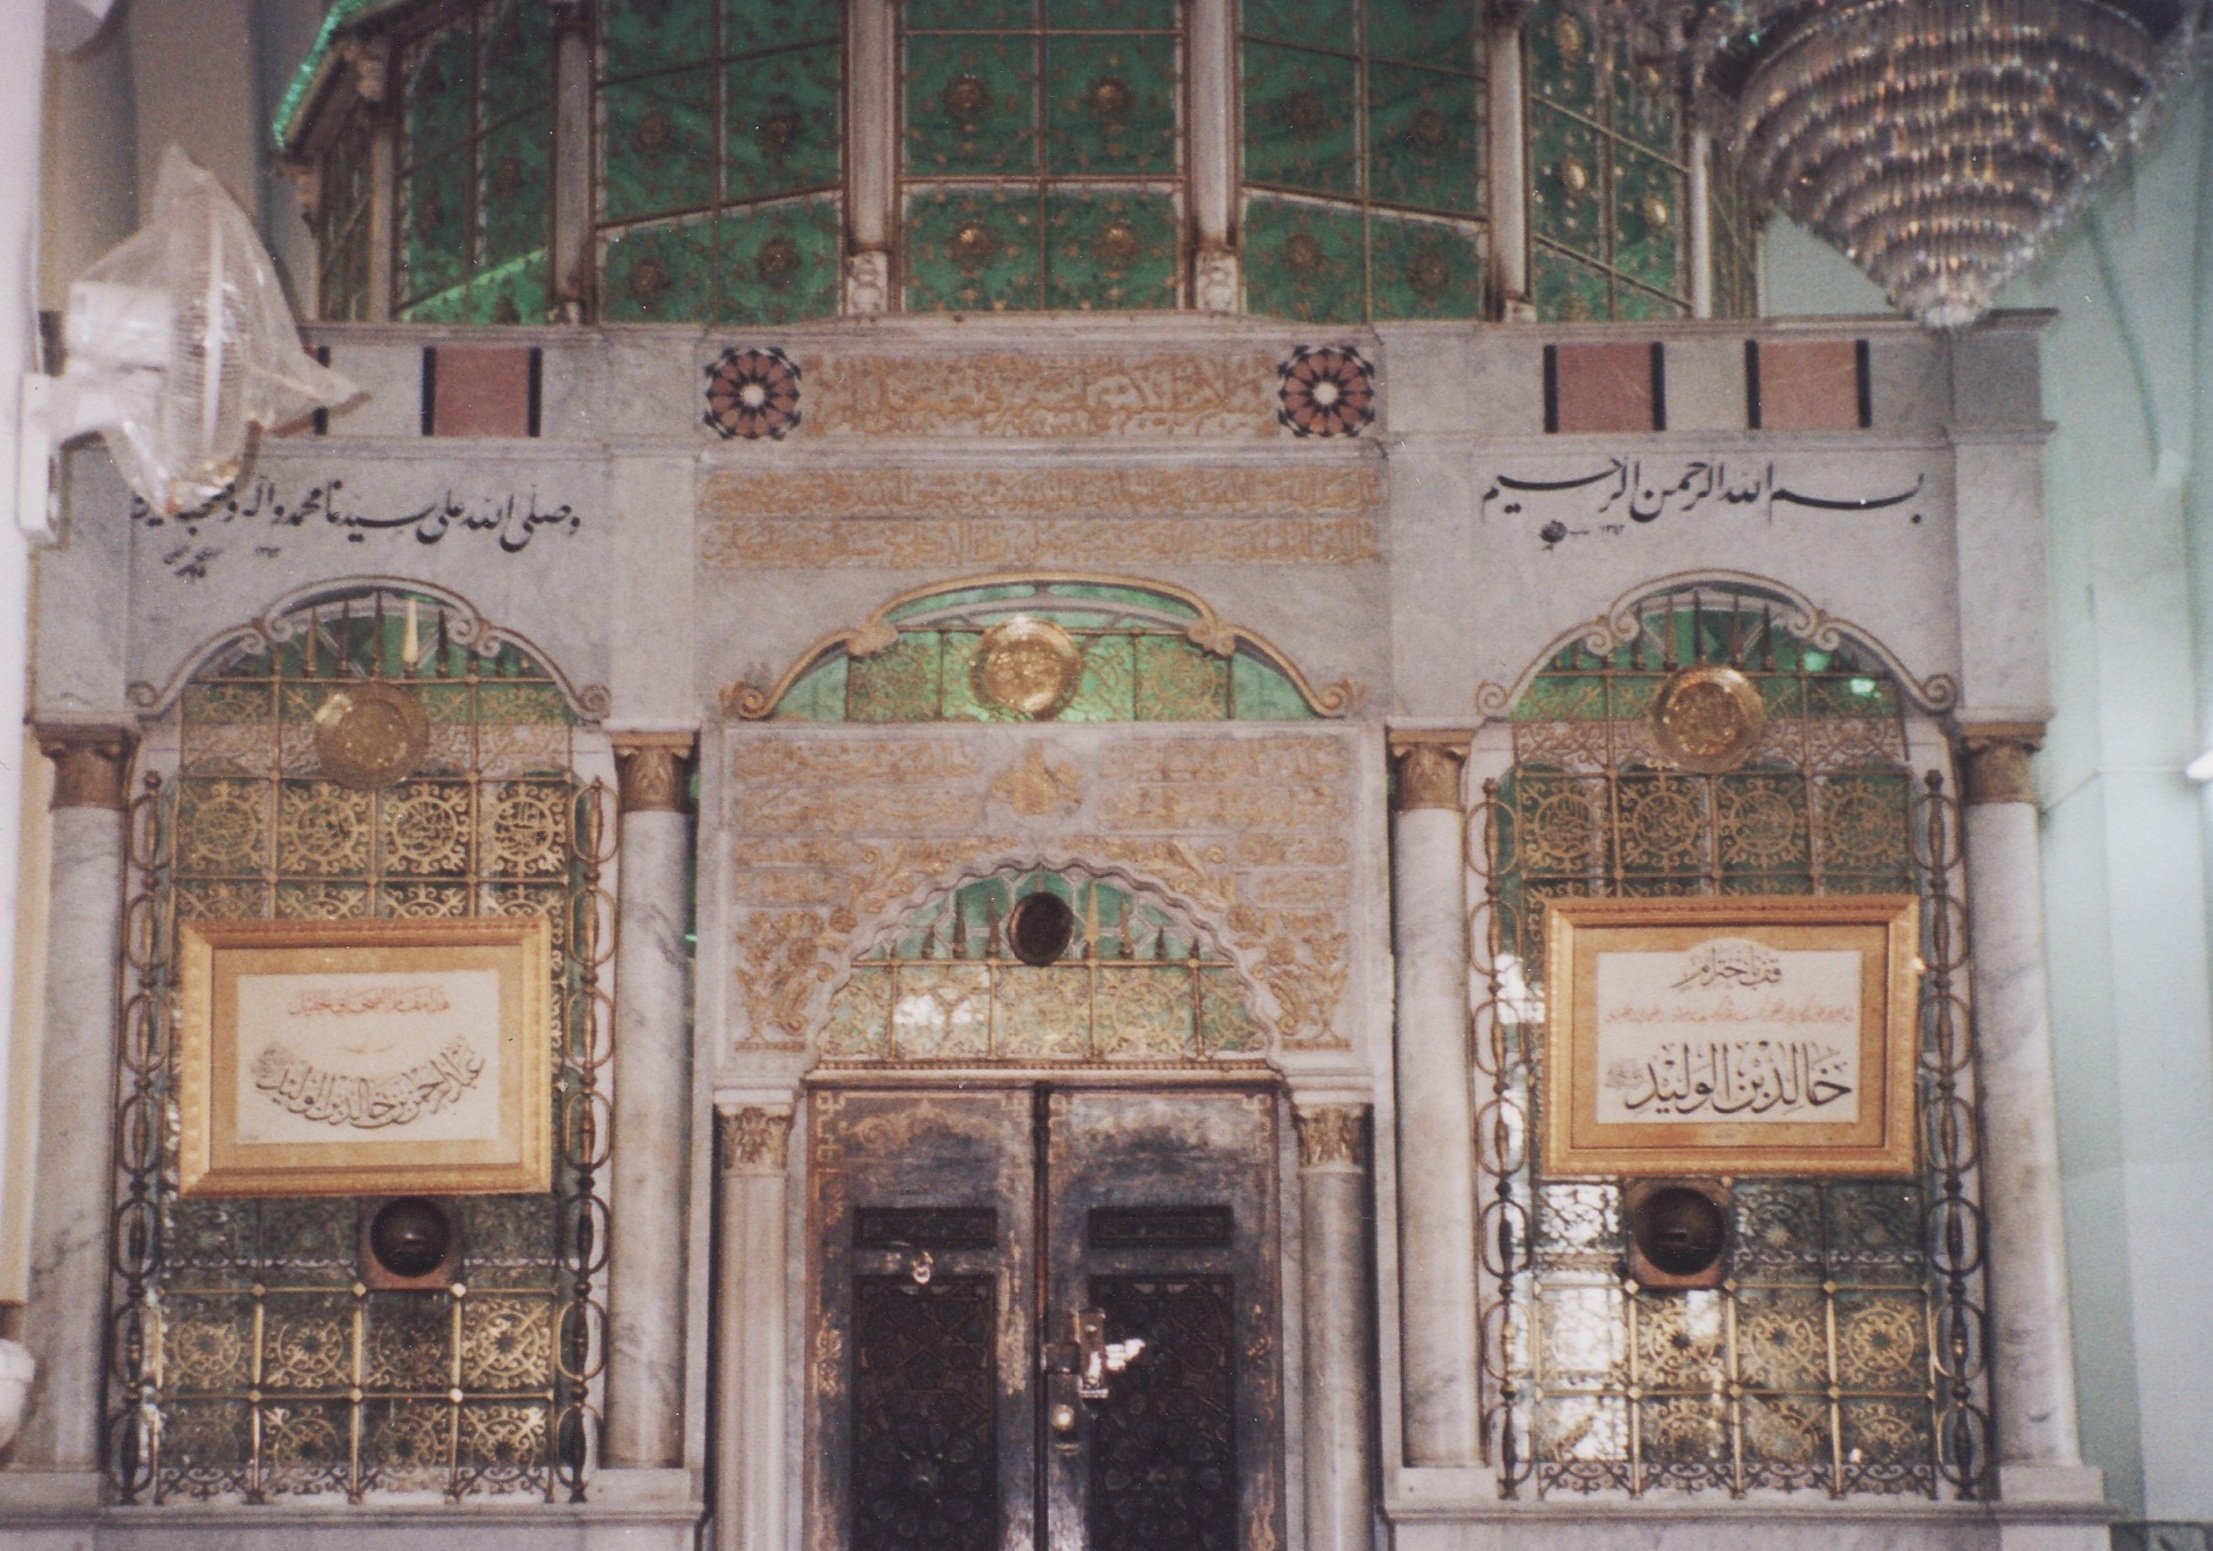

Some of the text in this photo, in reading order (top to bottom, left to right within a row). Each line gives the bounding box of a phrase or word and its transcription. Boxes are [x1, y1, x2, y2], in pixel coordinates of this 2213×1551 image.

[463, 494, 514, 531] الله
[1480, 457, 1925, 525] بسم الله الرحمن الرحيم
[1624, 1041, 1730, 1115] الوليد
[1752, 1041, 1853, 1115] خالد
